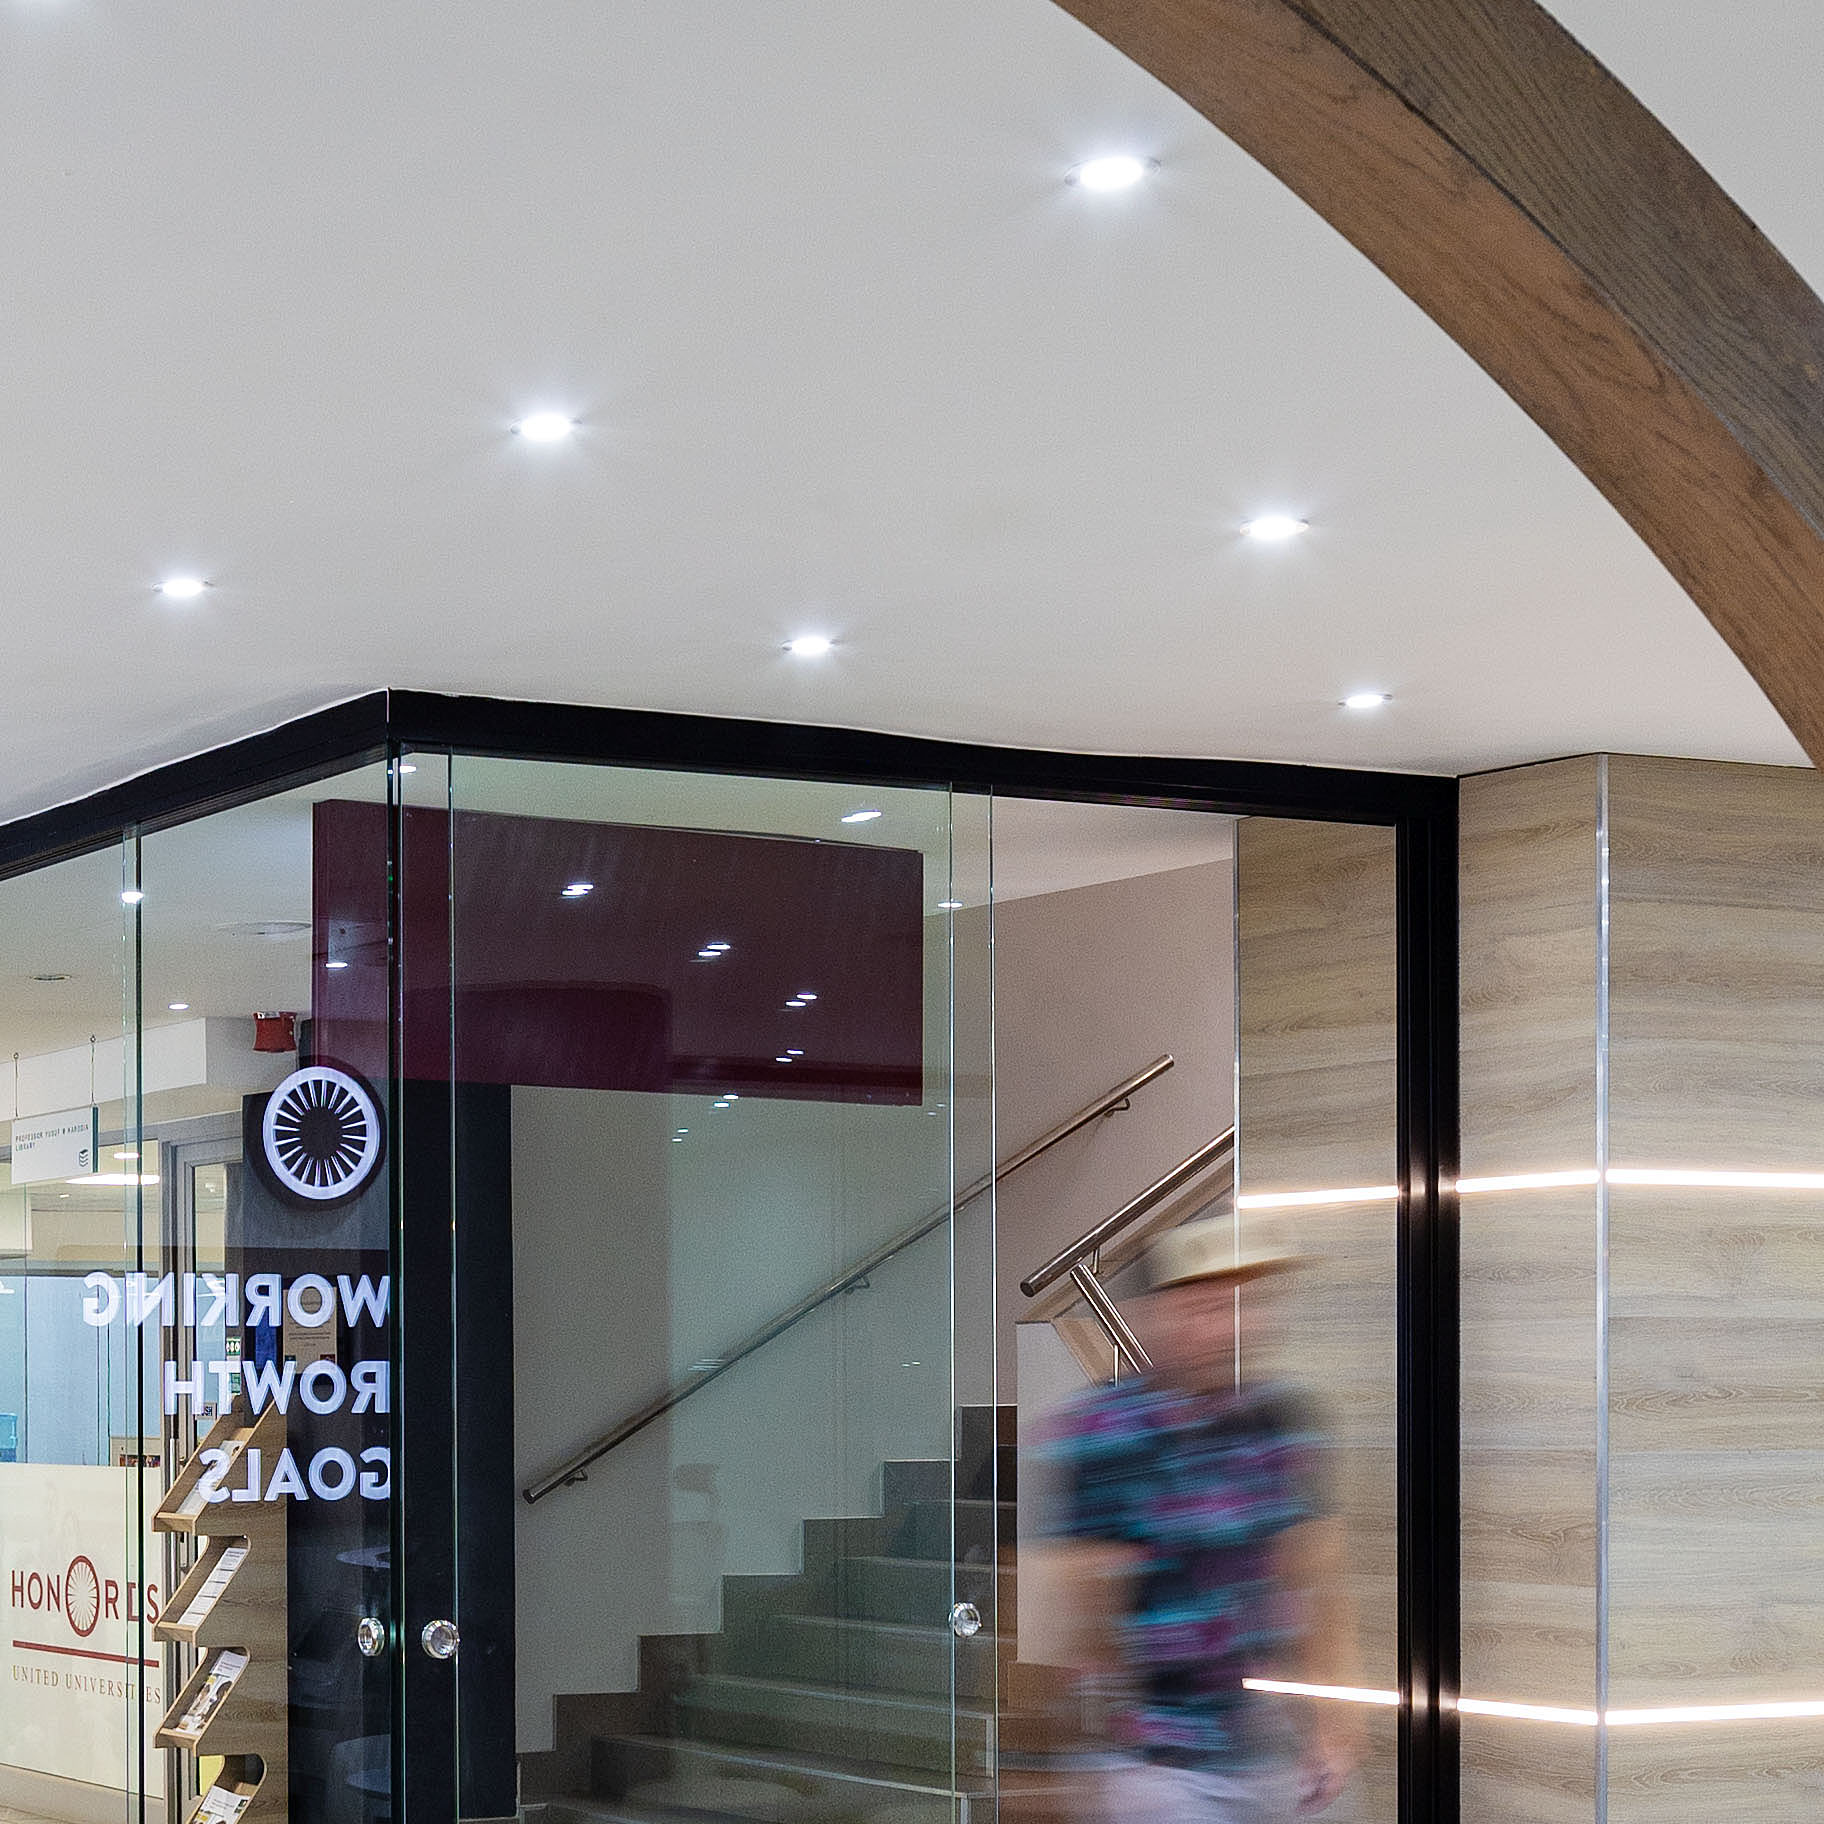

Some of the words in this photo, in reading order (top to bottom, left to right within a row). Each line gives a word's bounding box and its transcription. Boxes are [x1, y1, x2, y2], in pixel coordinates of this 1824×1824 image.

[16, 1142, 35, 1152] LIBRARY
[13, 1664, 59, 1687] UNITED
[65, 1673, 161, 1705] UNIVERSITES
